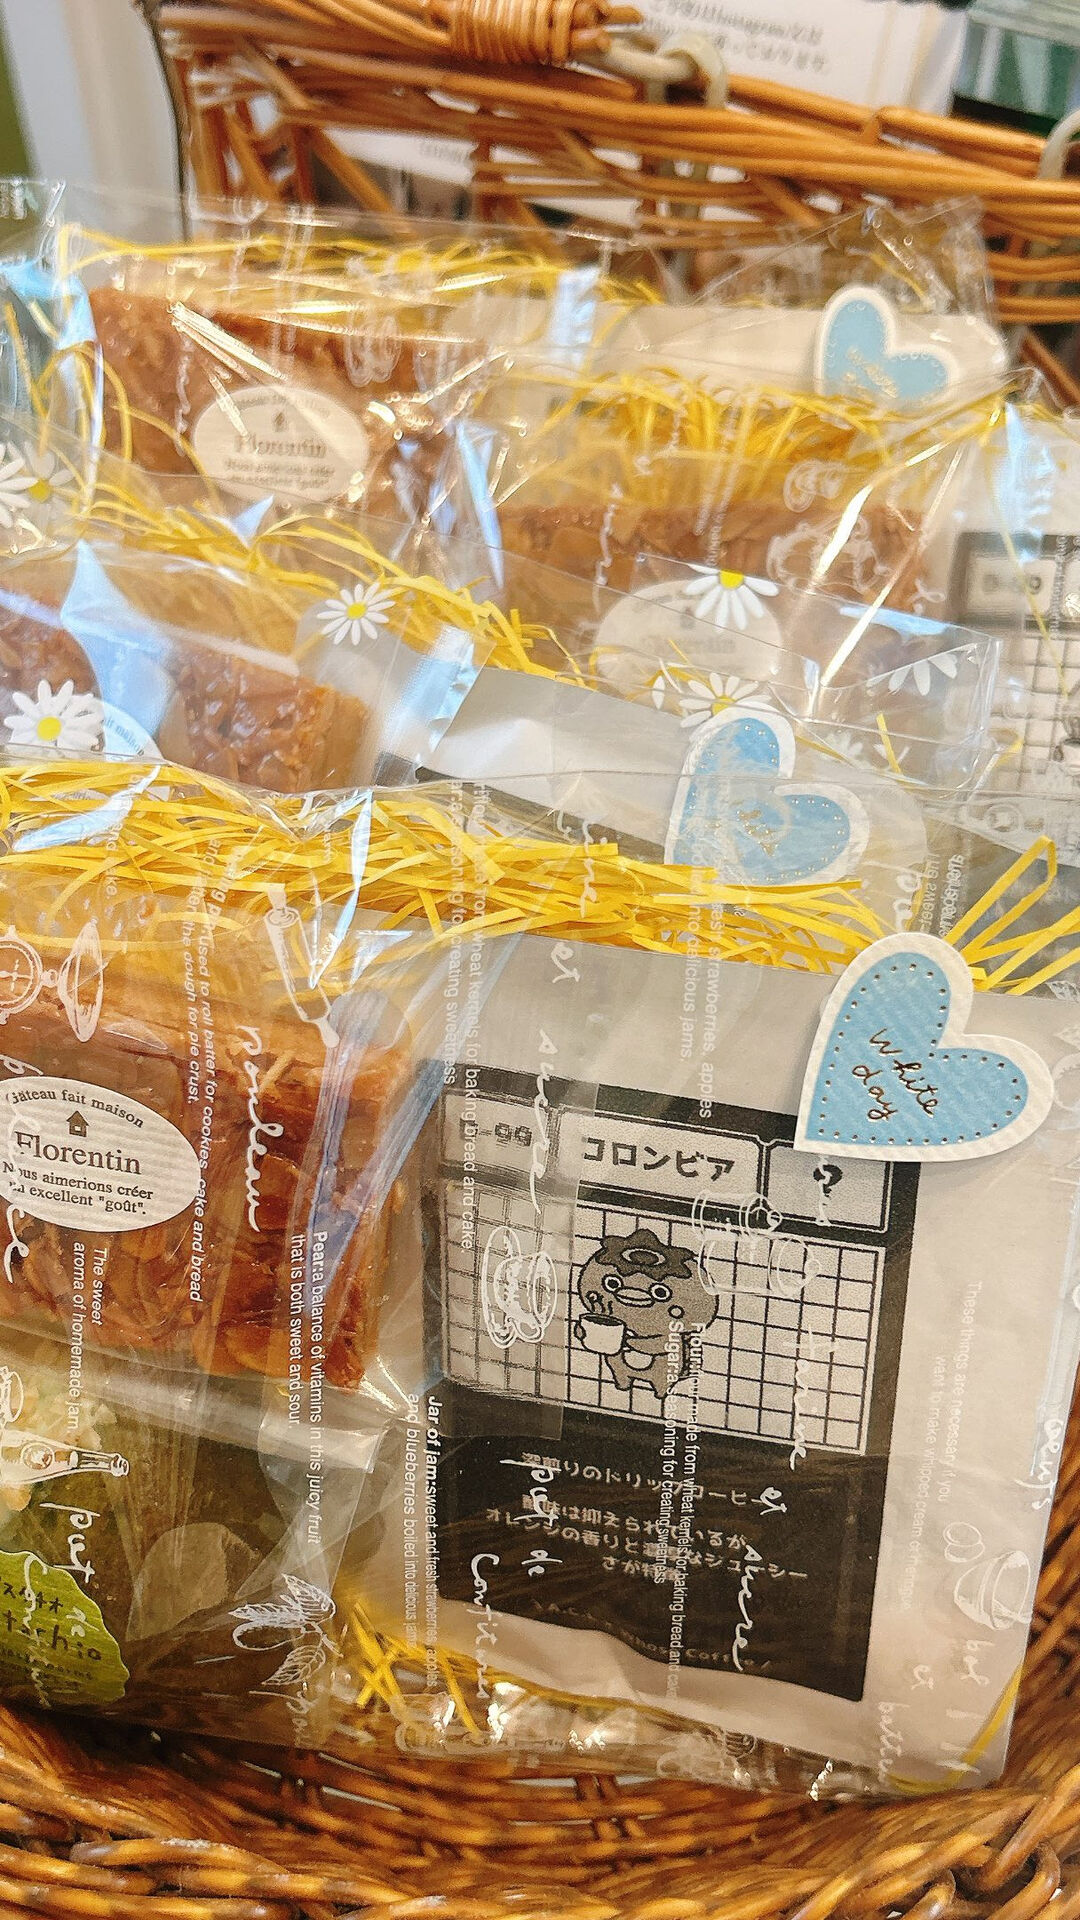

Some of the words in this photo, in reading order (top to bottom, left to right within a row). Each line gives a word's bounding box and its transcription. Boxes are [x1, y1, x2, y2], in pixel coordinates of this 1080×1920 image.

[183, 921, 195, 946] the
[184, 952, 198, 1001] dough
[444, 934, 462, 998] creating
[682, 941, 701, 1012] delicious
[200, 981, 211, 996] to
[187, 1007, 199, 1028] for
[202, 1000, 214, 1025] roll
[187, 1031, 200, 1057] pie
[203, 1029, 216, 1076] batter
[444, 1001, 459, 1085] sweetness
[679, 1017, 697, 1062] jams.
[187, 1061, 200, 1105] crust.
[697, 1062, 717, 1119] apples
[868, 1028, 941, 1118] White
[62, 1089, 87, 1105] fait
[91, 1099, 144, 1129] maison
[203, 1080, 217, 1103] for
[461, 1067, 480, 1121] baking
[852, 1064, 898, 1124] day
[15, 1130, 143, 1176] Florentin
[463, 1124, 479, 1171] bread
[581, 1136, 736, 1182] コロンビア
[30, 1186, 94, 1207] excellent
[42, 1172, 113, 1193] aimerions
[117, 1186, 154, 1200] créer
[195, 1178, 209, 1217] cake
[463, 1176, 476, 1206] and
[192, 1221, 205, 1253] and
[291, 1234, 306, 1263] that
[462, 1212, 476, 1252] cake.
[73, 1242, 86, 1290] aroma
[93, 1247, 108, 1276] The
[190, 1254, 205, 1302] bread
[291, 1266, 305, 1279] is
[73, 1294, 86, 1310] of
[91, 1280, 104, 1325] sweet
[290, 1282, 305, 1315] both
[311, 1285, 326, 1342] balance
[962, 1281, 982, 1325] These
[69, 1313, 86, 1398] homemade
[289, 1319, 303, 1361] sweet
[310, 1345, 326, 1359] of
[953, 1329, 975, 1369] things
[289, 1364, 303, 1391] and
[933, 1356, 946, 1388] want
[953, 1374, 967, 1396] are
[310, 1363, 326, 1423] vitamins
[405, 1393, 420, 1424] and
[428, 1395, 443, 1425] Jar
[930, 1391, 944, 1404] to
[65, 1402, 82, 1434] jam.
[289, 1394, 301, 1429] sour.
[660, 1392, 680, 1457] seasoning
[926, 1407, 941, 1444] make
[310, 1427, 324, 1439] in
[427, 1428, 441, 1446] of
[939, 1400, 964, 1467] necessary
[310, 1445, 324, 1470] this
[404, 1428, 420, 1515] blueberries
[662, 1460, 677, 1478] for
[684, 1445, 699, 1475] from
[917, 1447, 937, 1498] whipped
[306, 1474, 323, 1510] juicy
[656, 1480, 673, 1526] creating
[681, 1478, 696, 1514] wheat
[759, 1486, 788, 1516] et
[937, 1481, 951, 1501] you
[307, 1513, 322, 1545] fruit
[677, 1515, 694, 1553] kernels
[911, 1501, 928, 1537] cream
[404, 1518, 418, 1557] boiled
[426, 1532, 439, 1554] and
[404, 1560, 418, 1579] into
[425, 1556, 440, 1582] fresh
[521, 1549, 564, 1577] de
[654, 1528, 669, 1585] sweetness
[675, 1555, 690, 1570] for
[404, 1581, 418, 1620] delicious
[668, 1573, 689, 1611] baking
[66, 1607, 100, 1638] de
[669, 1614, 686, 1649] bread
[425, 1648, 439, 1687] apples
[668, 1650, 682, 1672] and
